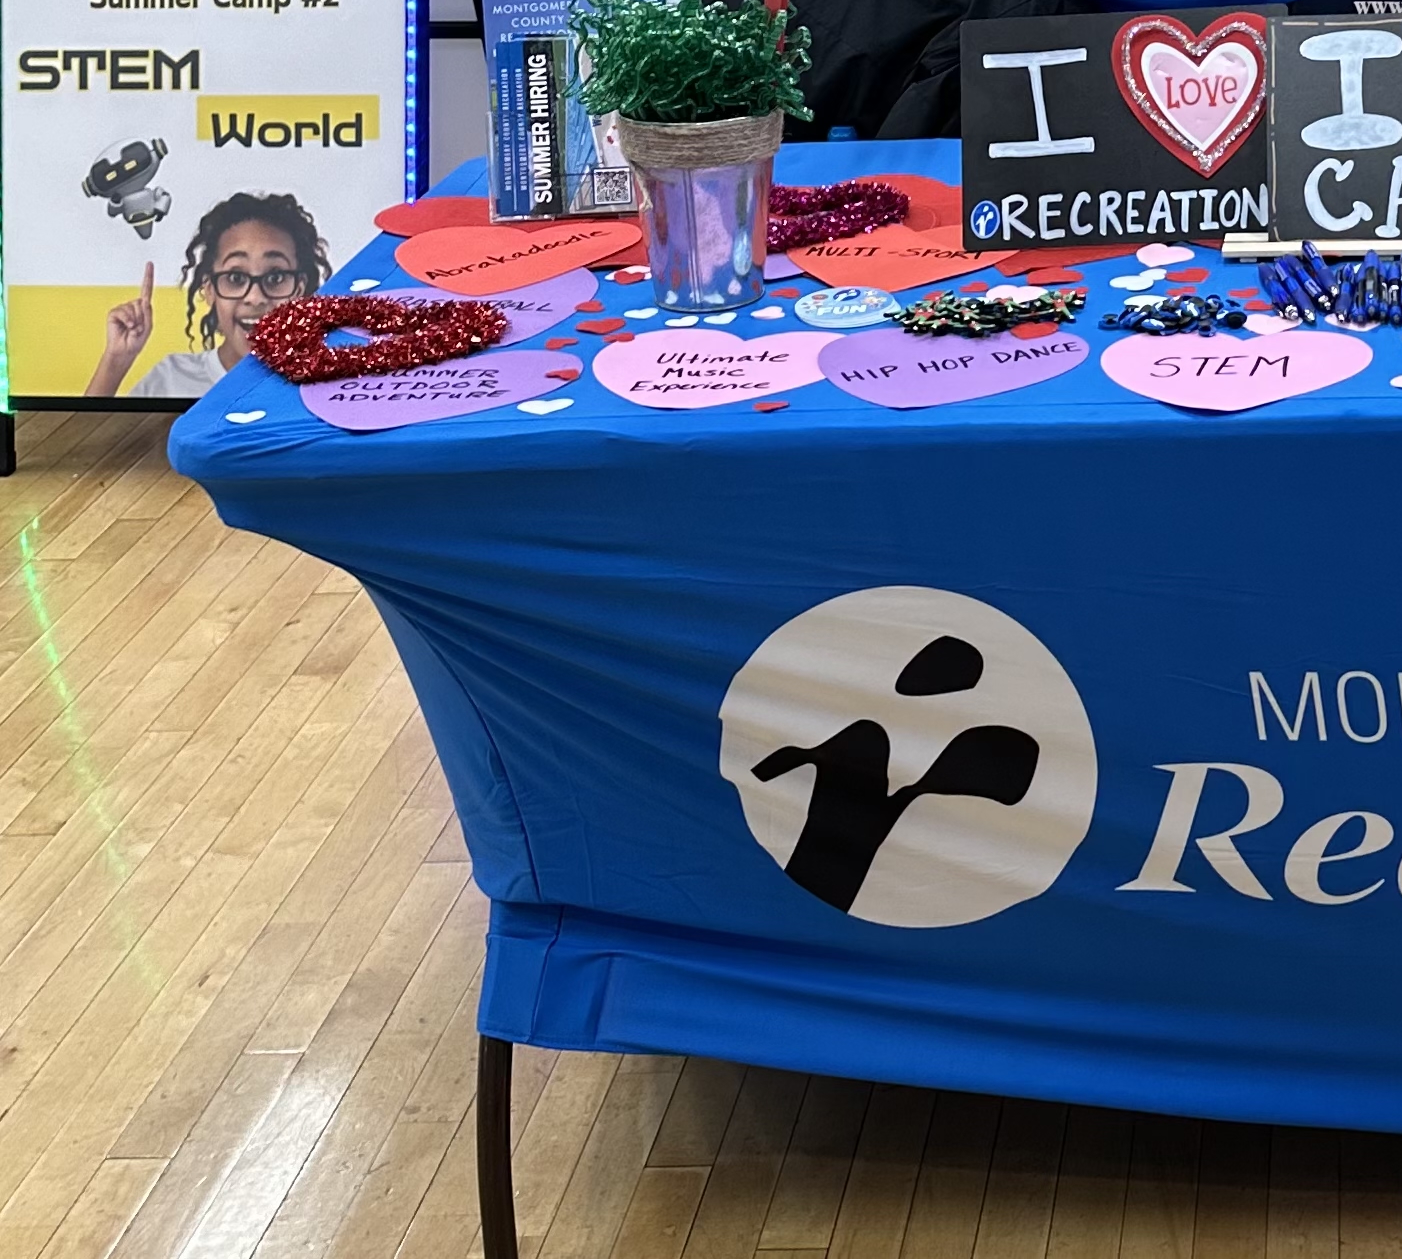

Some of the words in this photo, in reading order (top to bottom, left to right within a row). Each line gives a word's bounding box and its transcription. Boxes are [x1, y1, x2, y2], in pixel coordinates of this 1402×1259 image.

[510, 15, 565, 28] COUNTY
[18, 49, 200, 91] STEM
[527, 53, 549, 118] HIRING
[982, 47, 1095, 159] I
[211, 112, 364, 149] World
[529, 122, 553, 204] SUMMER
[1000, 182, 1268, 240] RECREATION
[804, 246, 882, 257] MULTI
[815, 303, 870, 317] FUN
[656, 350, 791, 365] Ultimate
[839, 364, 899, 384] HIP
[917, 354, 976, 374] HOP
[993, 340, 1082, 365] DANCE
[1149, 355, 1291, 379] STEM
[372, 367, 500, 379] UMMER
[661, 366, 746, 379] Music
[339, 379, 501, 391] OUTDOOR
[629, 379, 772, 394] Experience
